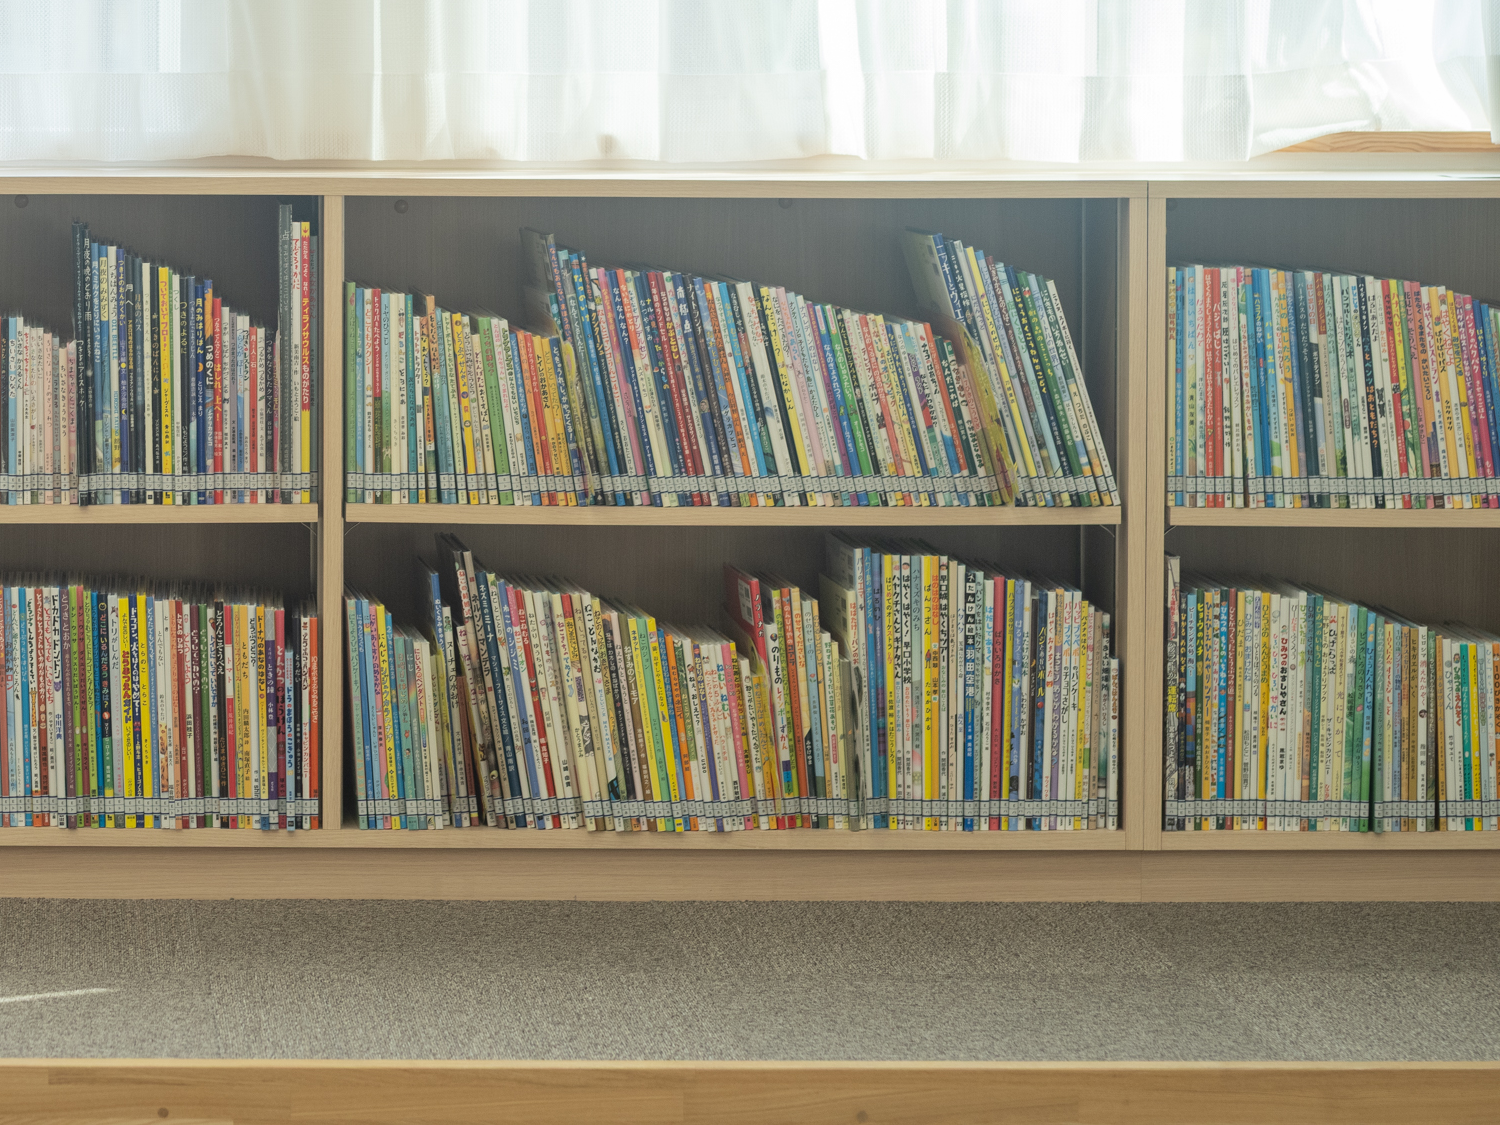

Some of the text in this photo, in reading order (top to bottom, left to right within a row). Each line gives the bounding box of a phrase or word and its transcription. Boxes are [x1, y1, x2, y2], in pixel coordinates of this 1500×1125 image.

[677, 286, 692, 333] 南極点
[205, 345, 213, 385] つめのくに
[772, 647, 783, 685] のりもの
[1280, 638, 1288, 715] ひみつのおすしやさん
